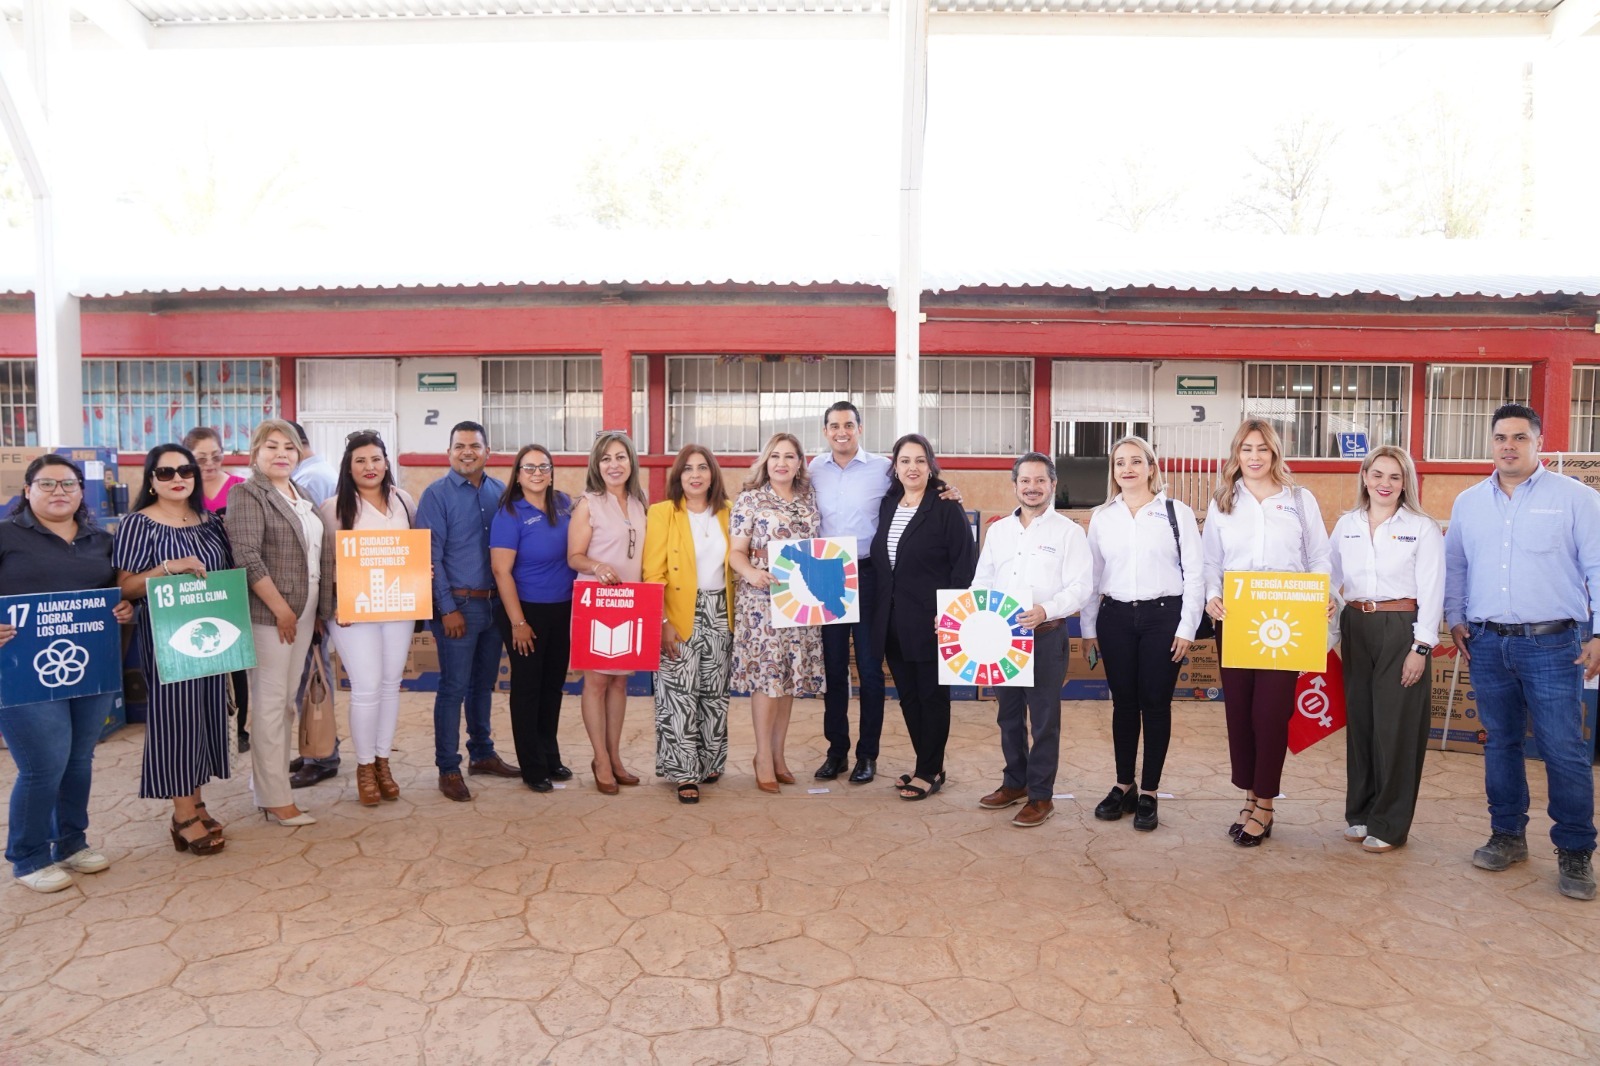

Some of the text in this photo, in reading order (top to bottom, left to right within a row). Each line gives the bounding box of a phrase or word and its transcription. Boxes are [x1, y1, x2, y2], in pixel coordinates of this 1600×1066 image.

[424, 410, 440, 425] 2
[1191, 406, 1206, 422] 3
[342, 537, 356, 557] 11
[360, 536, 400, 546] CIUDADES Y
[360, 546, 409, 556] COMUNIDADES
[360, 556, 405, 566] SOSTENIBLES
[179, 580, 206, 593] ACCIÓN
[1234, 579, 1244, 599] 7
[1250, 579, 1325, 590] ENERGÍA ASEQUIBLE
[154, 584, 175, 608] 13
[180, 590, 228, 605] POR EL CLIMA
[580, 588, 591, 607] 4
[596, 588, 634, 597] EDUCACIÓN
[1251, 591, 1324, 602] Y NO CONTAMINANTE
[37, 597, 106, 613] ALIANZAS PARA
[596, 599, 634, 608] DE CALIDAD
[7, 604, 30, 628] 17
[37, 612, 73, 625] LOGRAR
[37, 621, 104, 637] LOS OBJETIVOS
